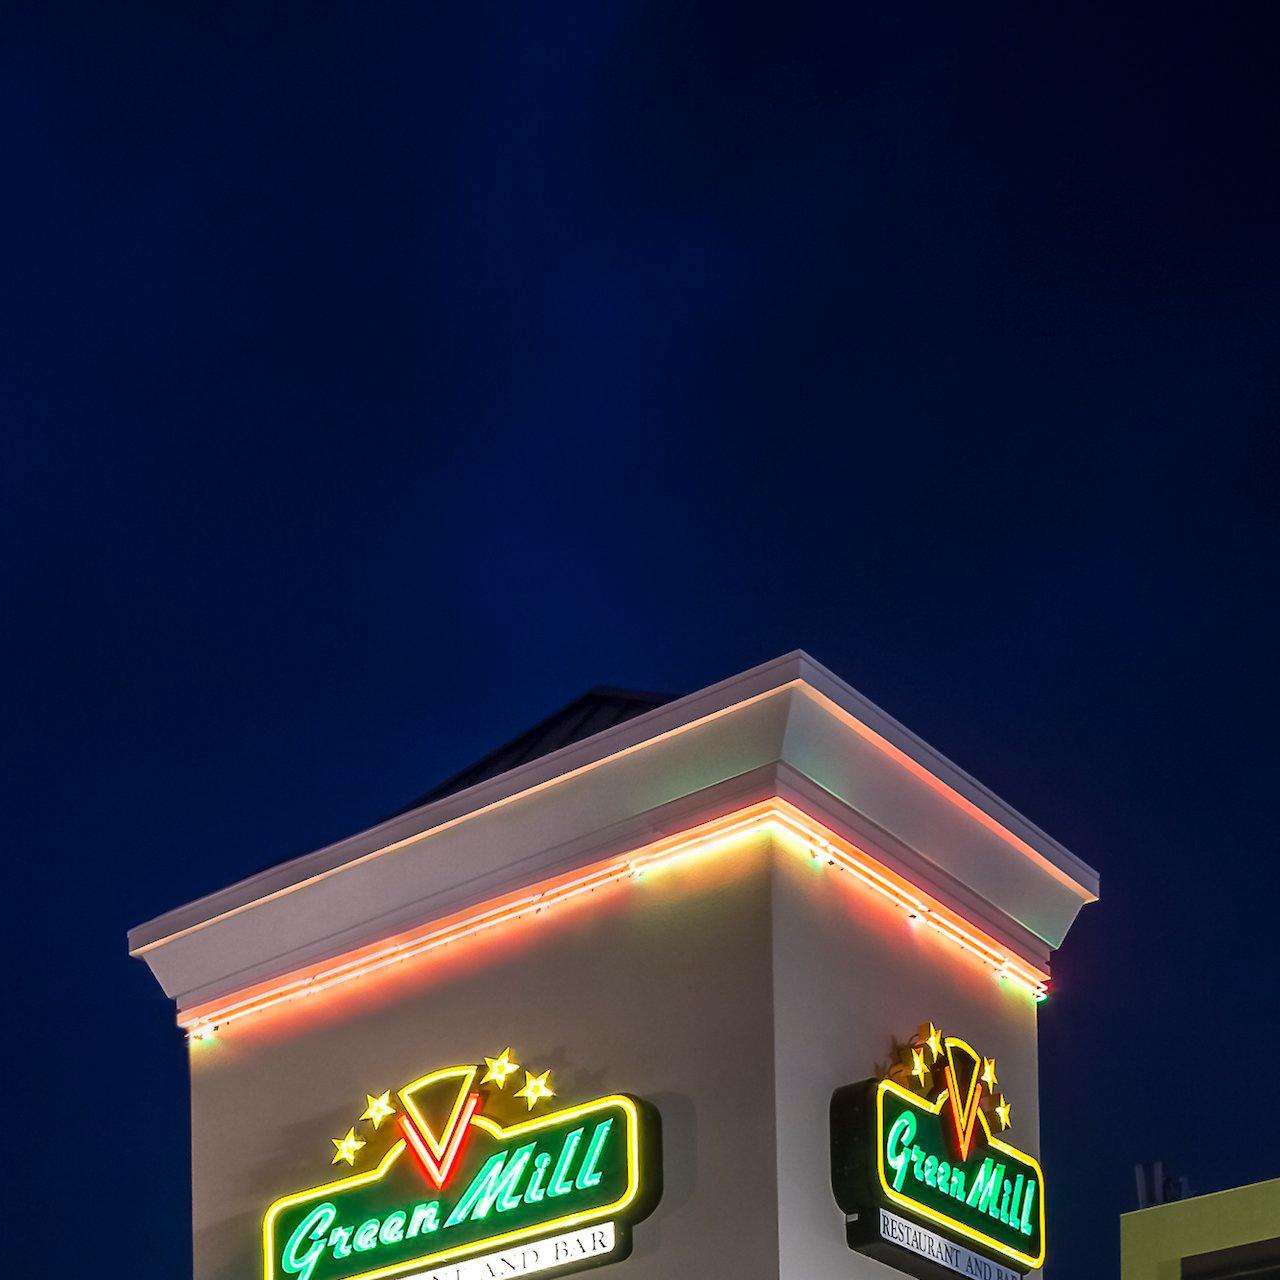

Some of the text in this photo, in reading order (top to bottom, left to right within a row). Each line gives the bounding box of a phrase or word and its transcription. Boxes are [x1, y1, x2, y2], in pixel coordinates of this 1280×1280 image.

[443, 1118, 614, 1229] Mill
[886, 1110, 1036, 1236] Green Mill
[480, 1249, 540, 1280] AND
[554, 1230, 608, 1261] BAR
[882, 1214, 960, 1268] RESTAURANT
